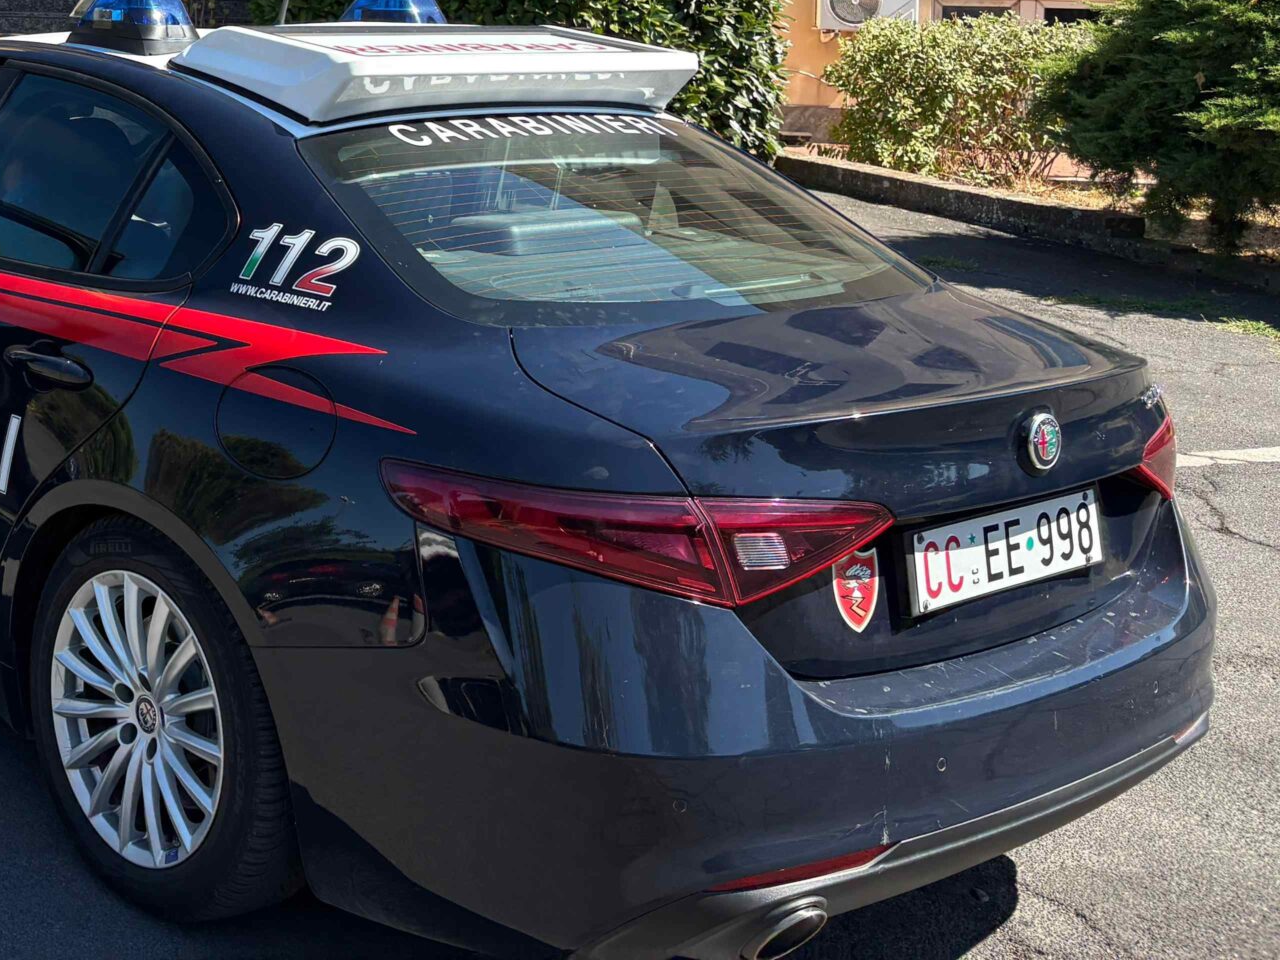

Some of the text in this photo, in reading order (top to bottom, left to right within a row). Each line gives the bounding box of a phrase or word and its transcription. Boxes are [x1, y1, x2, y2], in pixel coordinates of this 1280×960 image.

[388, 113, 677, 147] CARABINIERI
[239, 222, 361, 297] 112
[230, 282, 332, 312] WWW.CARABINIERI.IT
[923, 502, 1094, 599] CC EE 998
